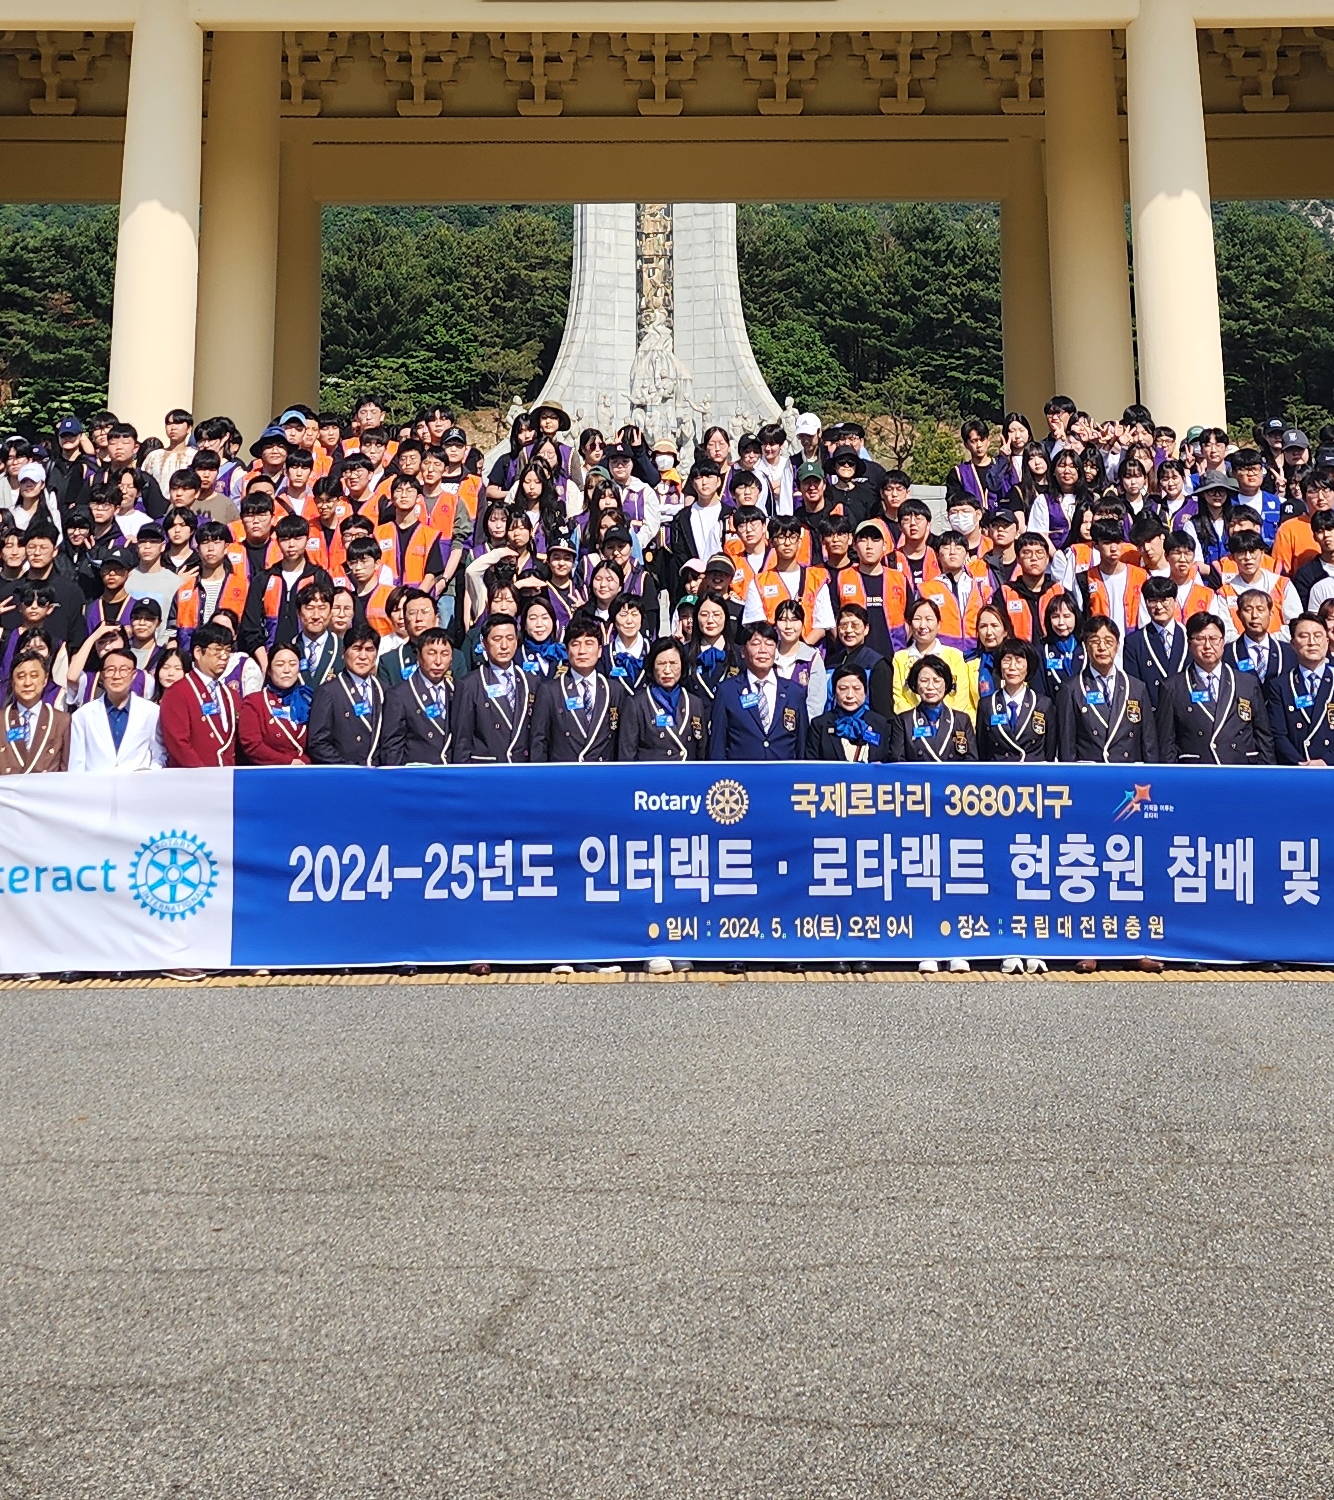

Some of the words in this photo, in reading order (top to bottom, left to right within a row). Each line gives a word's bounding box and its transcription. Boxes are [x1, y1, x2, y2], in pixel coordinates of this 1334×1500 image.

[634, 790, 702, 815] Rotary
[790, 781, 931, 819] 국제로타리
[944, 783, 1073, 819] 3680지구
[288, 839, 558, 902] 2024-25년도
[579, 834, 758, 903] 인터랙트
[808, 833, 989, 901] 로타랙트
[1009, 833, 1144, 903] 현충원
[1167, 835, 1254, 905] 참배
[1280, 838, 1320, 906] 및
[666, 916, 698, 941] 일시
[719, 917, 765, 940] 2024.
[794, 914, 842, 940] 18(토)
[847, 915, 881, 939] 오전
[886, 914, 913, 939] 9시
[957, 915, 991, 938] 장소
[1010, 915, 1165, 939] 국립대전현충원
